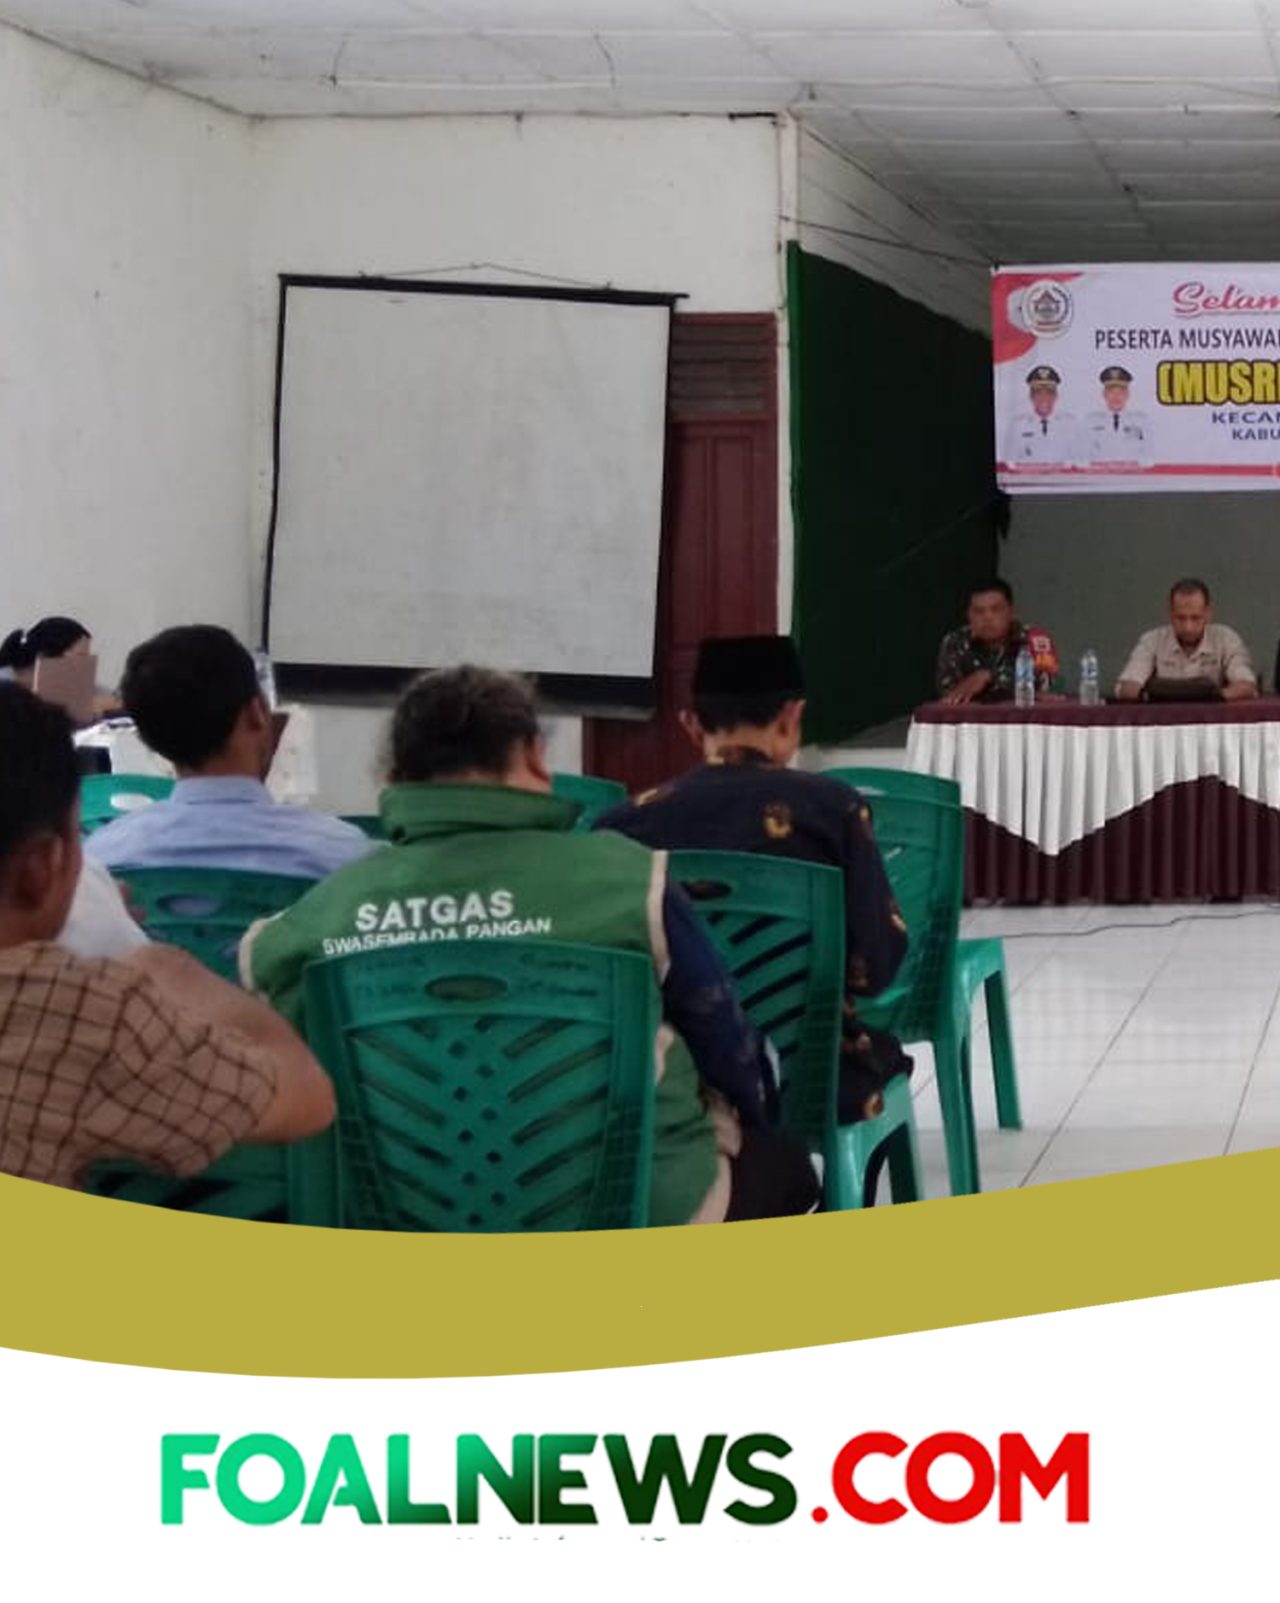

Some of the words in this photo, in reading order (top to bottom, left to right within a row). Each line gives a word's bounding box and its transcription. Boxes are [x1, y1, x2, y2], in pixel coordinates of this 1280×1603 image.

[1095, 328, 1174, 350] PESERTA
[355, 890, 514, 931] SATGAS
[466, 917, 552, 939] PANGAN
